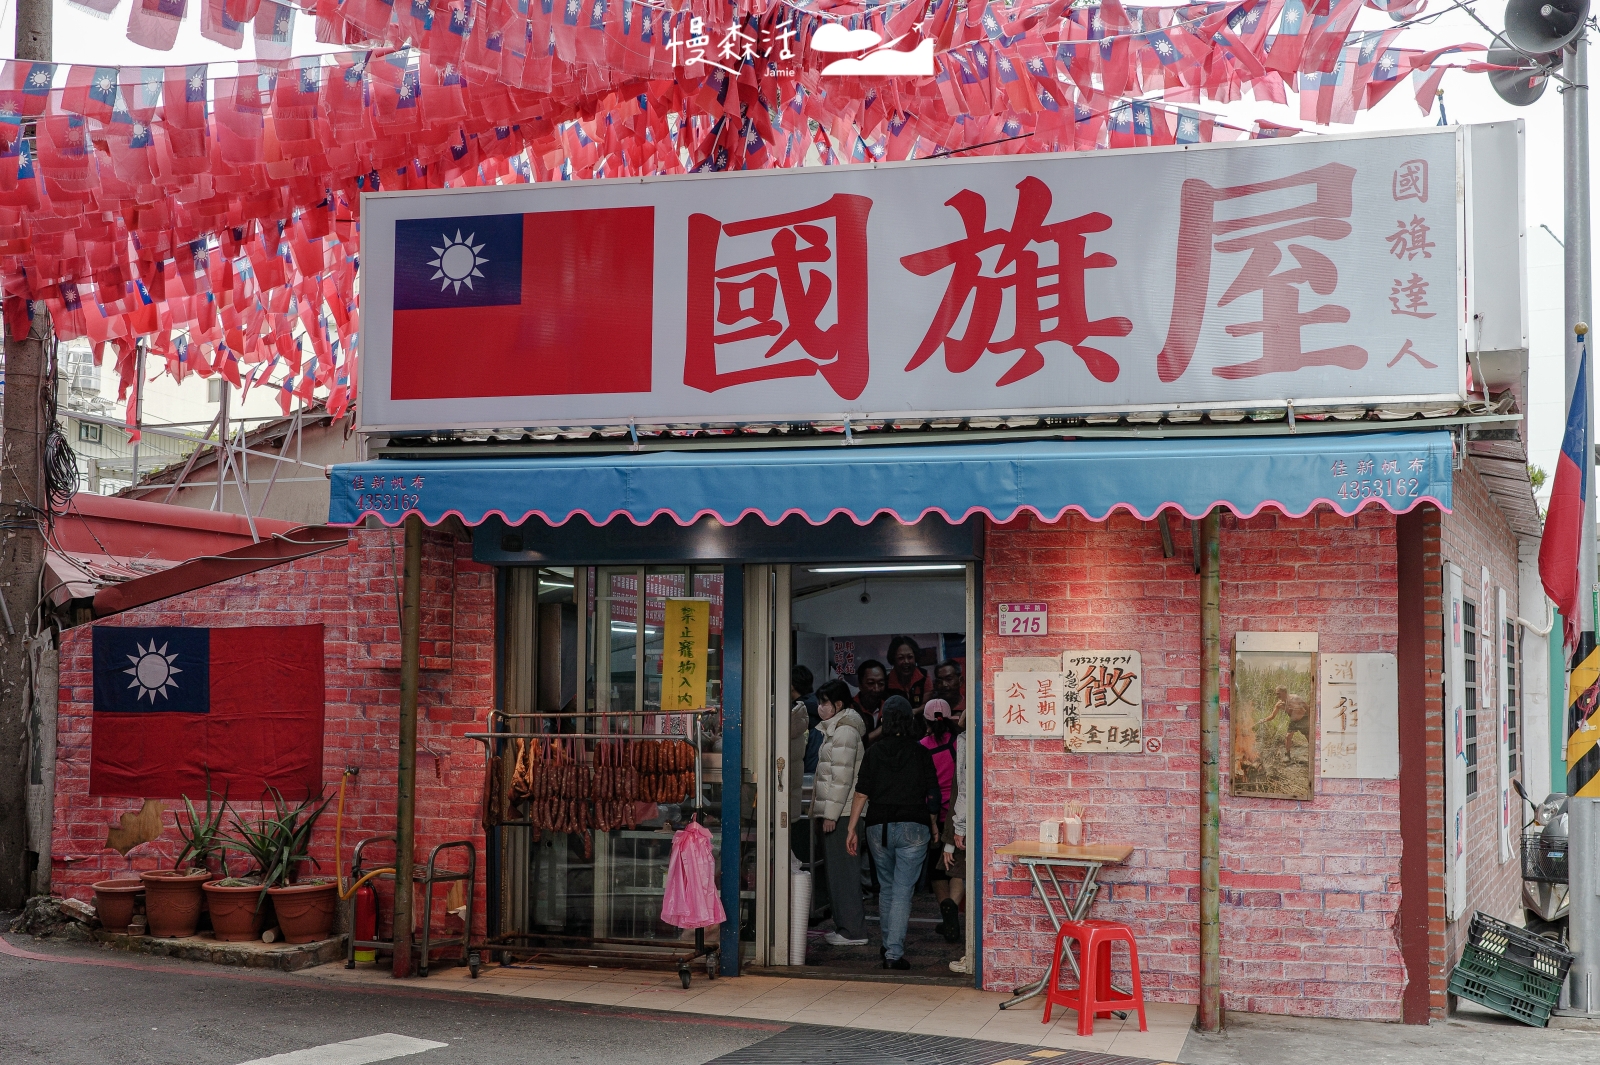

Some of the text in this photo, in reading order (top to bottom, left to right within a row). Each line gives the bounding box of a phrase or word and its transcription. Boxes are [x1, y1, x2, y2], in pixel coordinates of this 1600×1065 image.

[1386, 159, 1439, 370] 國旗達人
[684, 163, 1369, 400] 國旗屋
[1331, 458, 1426, 478] 佳新帆布
[352, 475, 426, 492] 佳新帆布
[1338, 479, 1419, 500] 4353162
[356, 494, 420, 512] 4353162
[1012, 617, 1041, 633] 215
[678, 606, 697, 707] 禁止寵物入內
[1003, 682, 1030, 725] 公休
[1037, 679, 1057, 732] 星期四
[1084, 725, 1141, 748] 全日班
